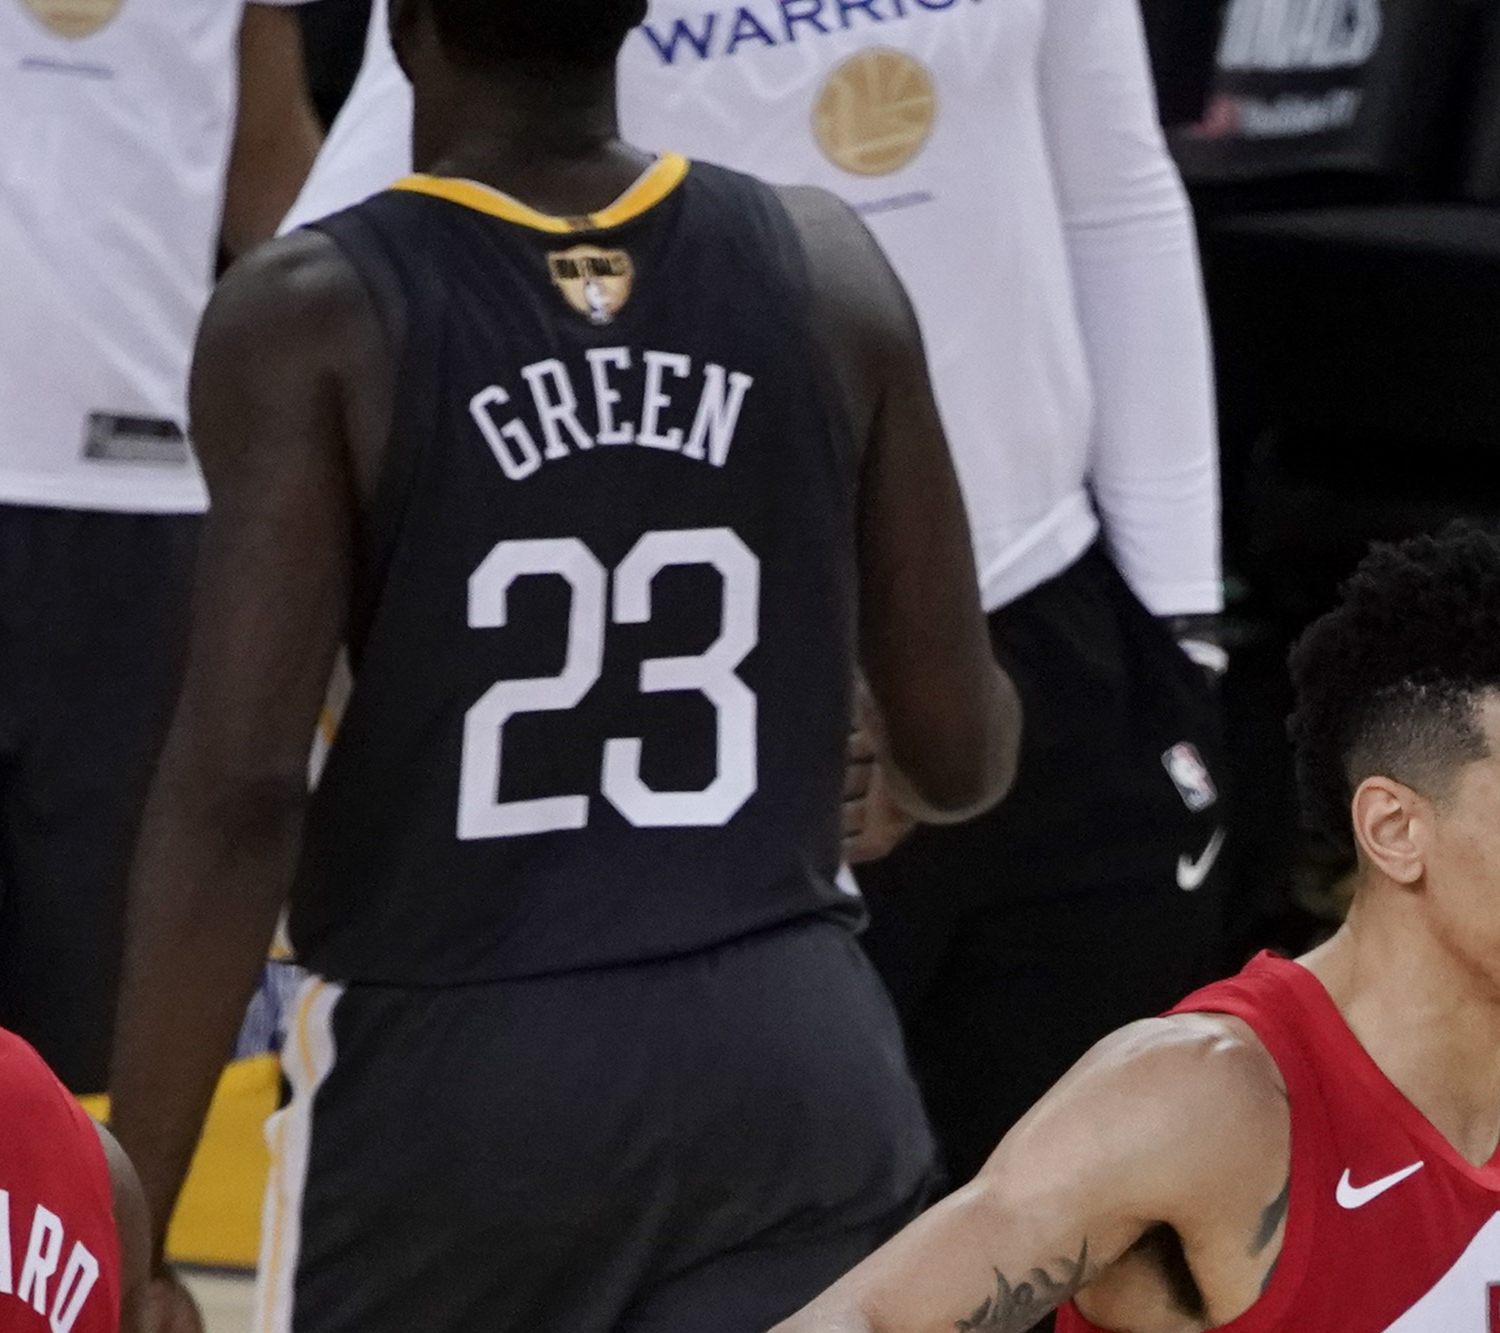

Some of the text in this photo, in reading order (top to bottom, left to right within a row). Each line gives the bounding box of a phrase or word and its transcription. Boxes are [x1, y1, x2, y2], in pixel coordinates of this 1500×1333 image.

[642, 0, 982, 66] WARR
[468, 346, 754, 481] GREEN
[456, 527, 762, 841] 23
